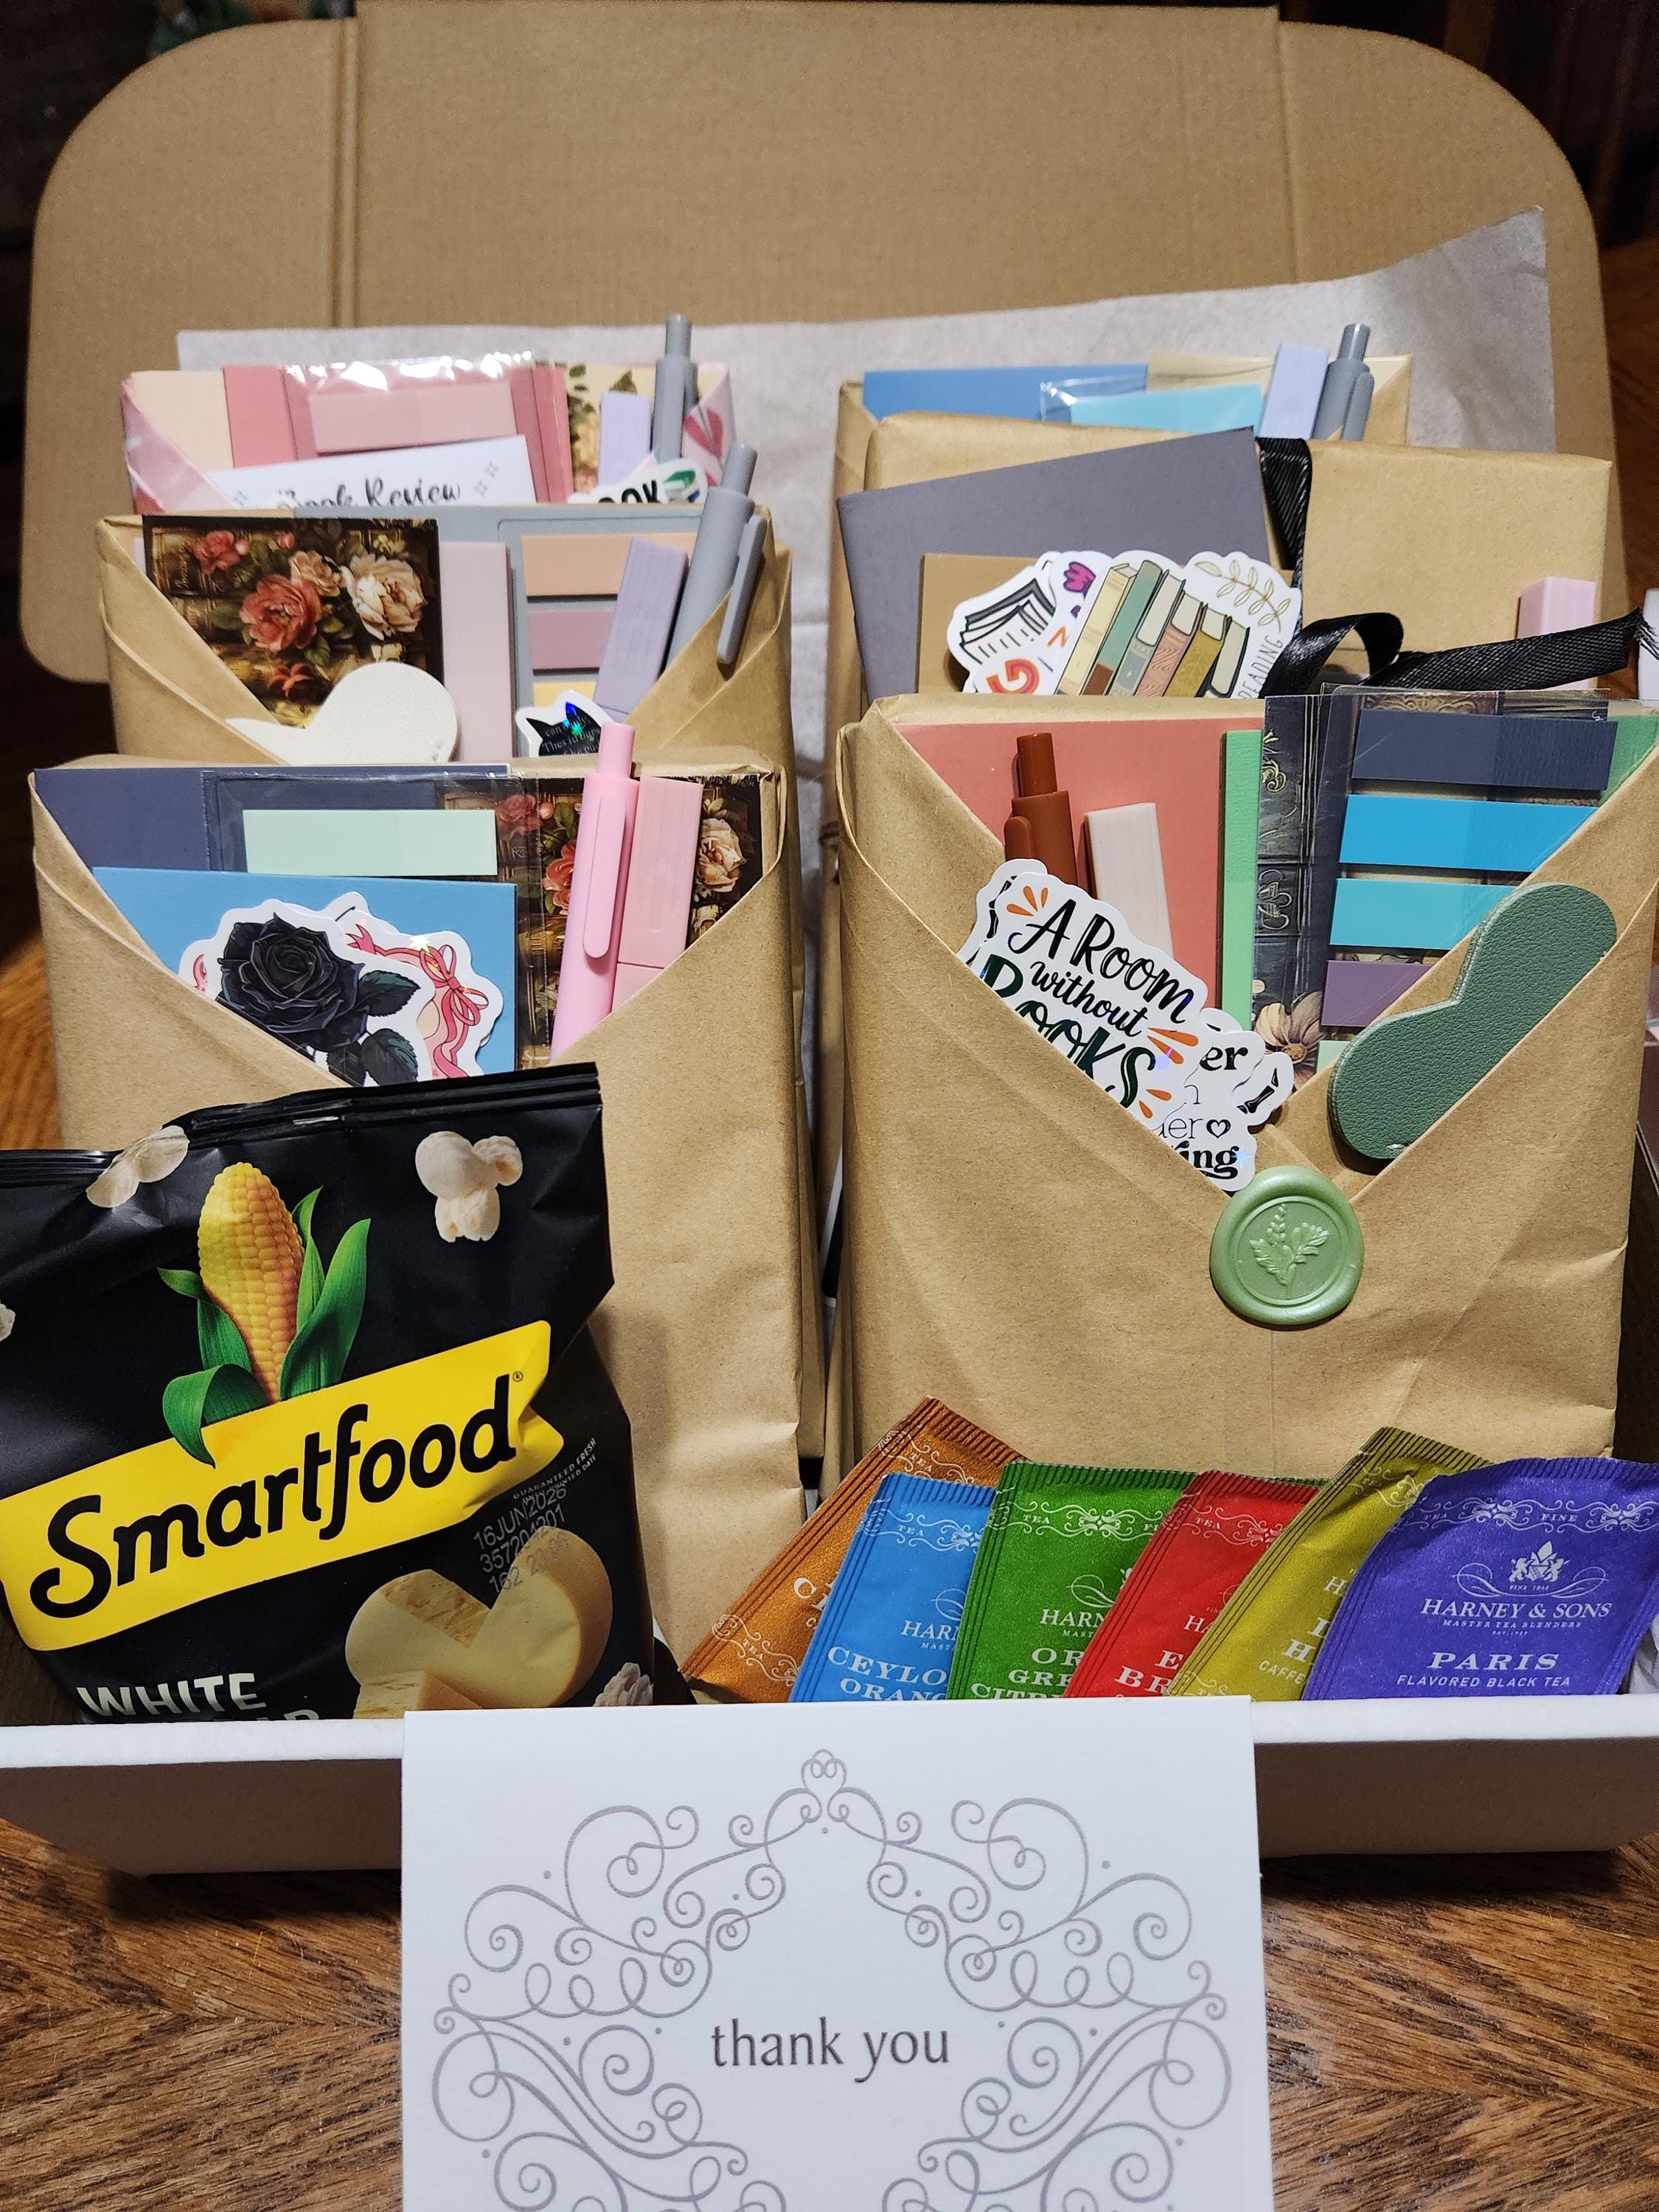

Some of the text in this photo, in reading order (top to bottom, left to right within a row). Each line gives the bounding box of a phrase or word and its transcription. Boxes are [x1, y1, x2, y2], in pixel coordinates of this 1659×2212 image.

[599, 480, 661, 503] OK
[1008, 899, 1077, 959] A
[1030, 961, 1149, 1037] without
[576, 1437, 597, 1466] FRESH
[909, 1453, 933, 1472] TEA
[30, 1374, 518, 1618] Smartfood
[1023, 1514, 1050, 1524] TEA
[1195, 1517, 1221, 1529] TEA
[1541, 1514, 1578, 1522] FINE
[897, 1525, 924, 1536] TEA
[1420, 1598, 1613, 1618] HARNEY & SONS
[1443, 1619, 1490, 1628] MASTER
[742, 1638, 764, 1660] TEA
[922, 1642, 956, 1651] MAST
[1427, 1652, 1559, 1671] PARIS
[1397, 1674, 1570, 1687] FLAVORED BLACK TEA
[76, 1673, 267, 1717] WHITE
[712, 2017, 948, 2083] thank you
